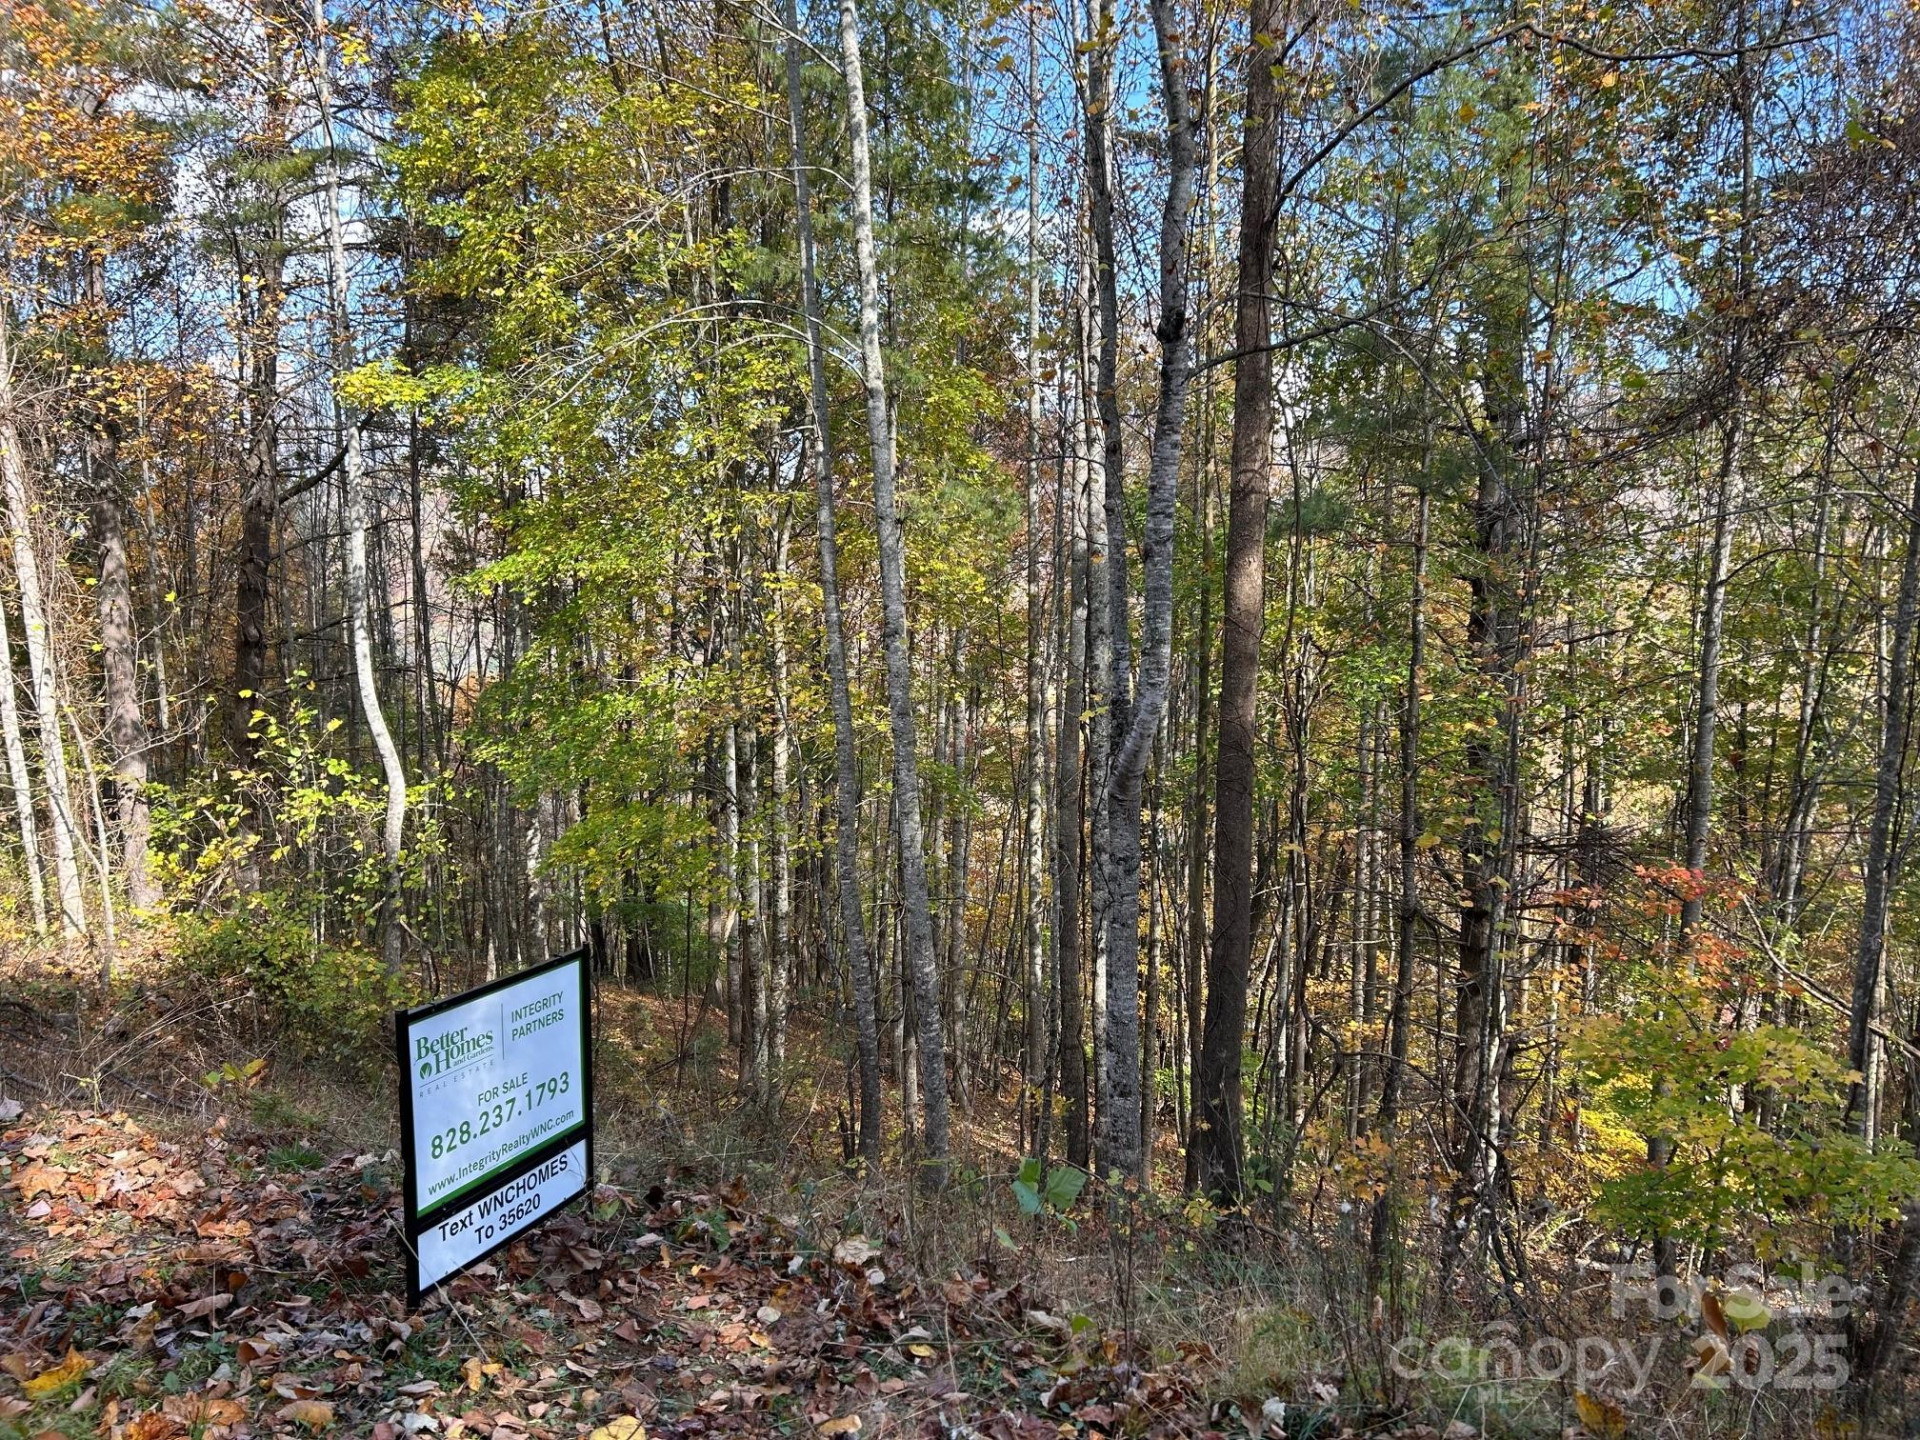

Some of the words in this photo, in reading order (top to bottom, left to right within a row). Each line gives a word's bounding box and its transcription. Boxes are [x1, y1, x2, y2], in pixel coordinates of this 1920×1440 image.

[511, 991, 563, 1023] INTEGRITY
[511, 1009, 564, 1041] PARTNERS
[415, 1026, 468, 1062] Better
[434, 1031, 494, 1076] Homes
[453, 1054, 465, 1067] and
[419, 1081, 448, 1098] REAL
[453, 1060, 495, 1083] ESTATE
[477, 1078, 500, 1106] FOR
[502, 1072, 529, 1094] SALE
[431, 1071, 570, 1160] 828.237.1793
[428, 1109, 575, 1196] www.IntegrityRealtyWNC.com
[438, 1212, 473, 1242] Text
[478, 1154, 568, 1219] WNCHOMES
[474, 1224, 494, 1245] To
[498, 1193, 541, 1232] 35620
